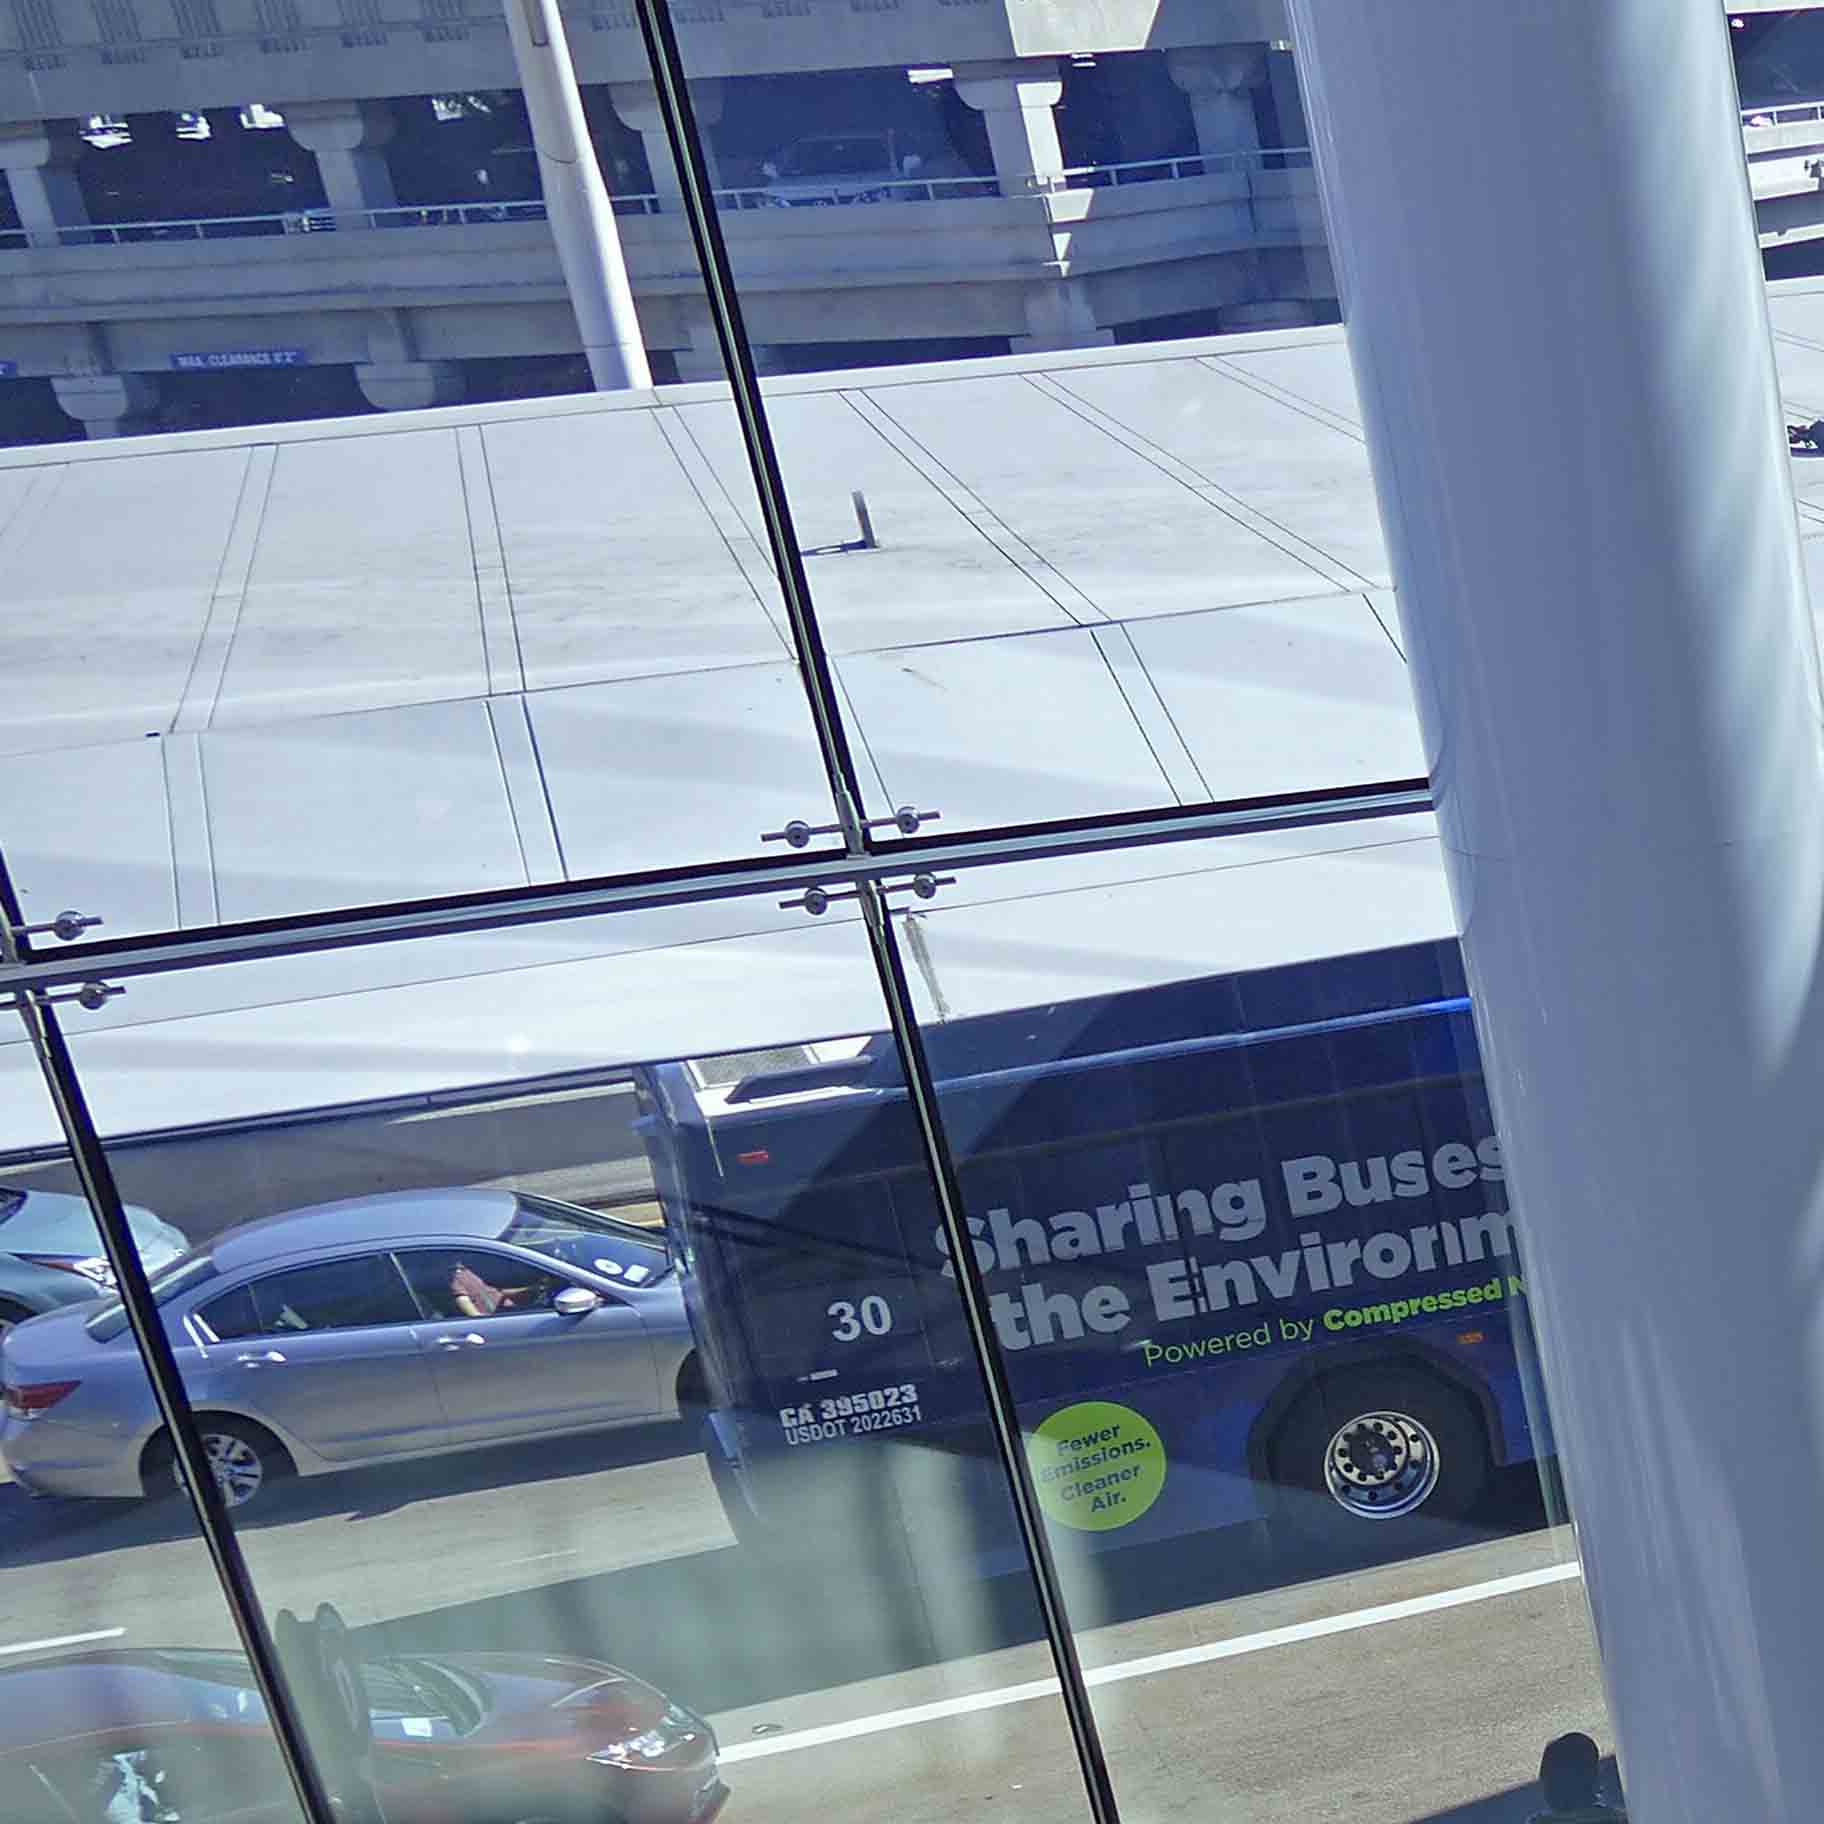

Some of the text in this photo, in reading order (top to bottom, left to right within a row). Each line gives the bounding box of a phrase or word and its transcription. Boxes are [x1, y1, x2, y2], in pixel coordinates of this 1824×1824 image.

[827, 1295, 893, 1342] 30
[989, 1282, 1132, 1351] the
[1143, 1321, 1272, 1368] Powered
[1279, 1318, 1314, 1342] by
[1323, 1277, 1503, 1331] Compressed
[779, 1383, 919, 1428] CA 395023
[785, 1404, 923, 1446] USDOT 2022631
[1040, 1437, 1152, 1482] Emissions.
[1056, 1423, 1121, 1456] Fewer
[1061, 1463, 1141, 1501] Cleaner
[1091, 1491, 1127, 1513] Air.
